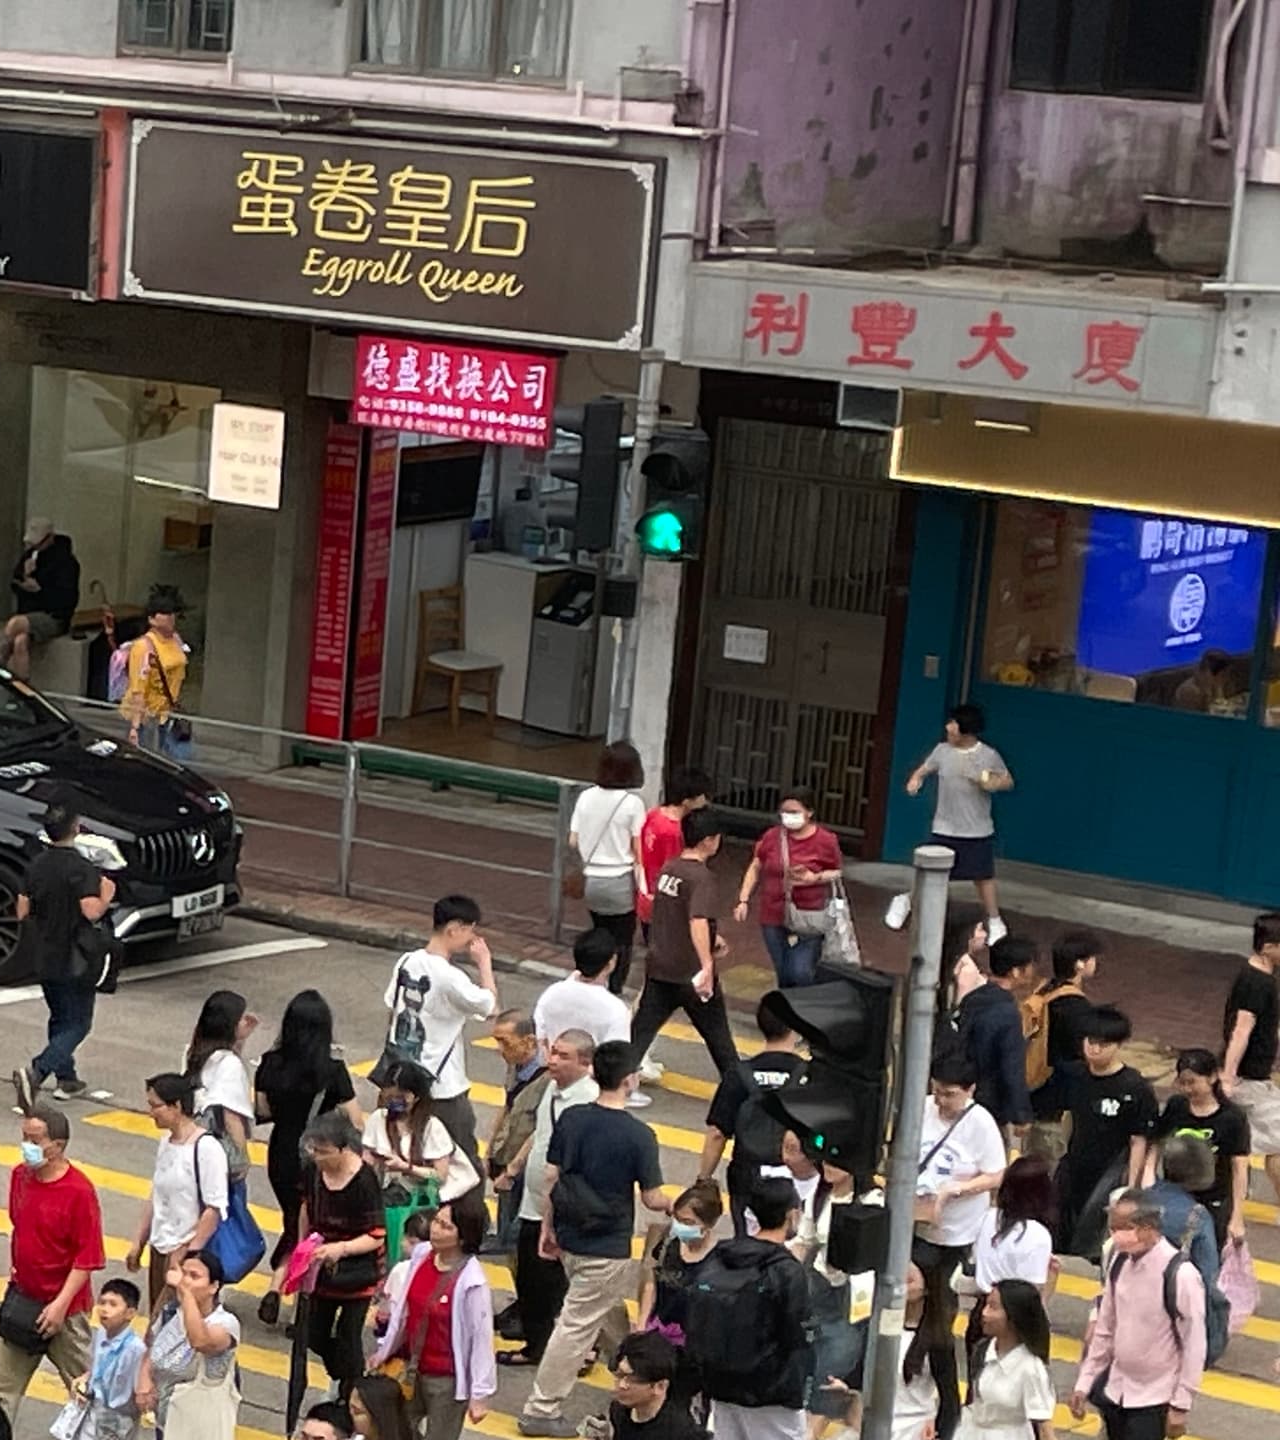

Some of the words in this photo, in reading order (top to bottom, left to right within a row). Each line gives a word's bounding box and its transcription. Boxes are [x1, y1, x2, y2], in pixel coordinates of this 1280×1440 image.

[232, 151, 536, 257] 蛋卷皇后
[302, 248, 414, 297] Eggroll
[418, 260, 523, 303] Queen
[362, 343, 547, 410] 德盛找換公司
[744, 292, 1145, 392] 利豐大廈
